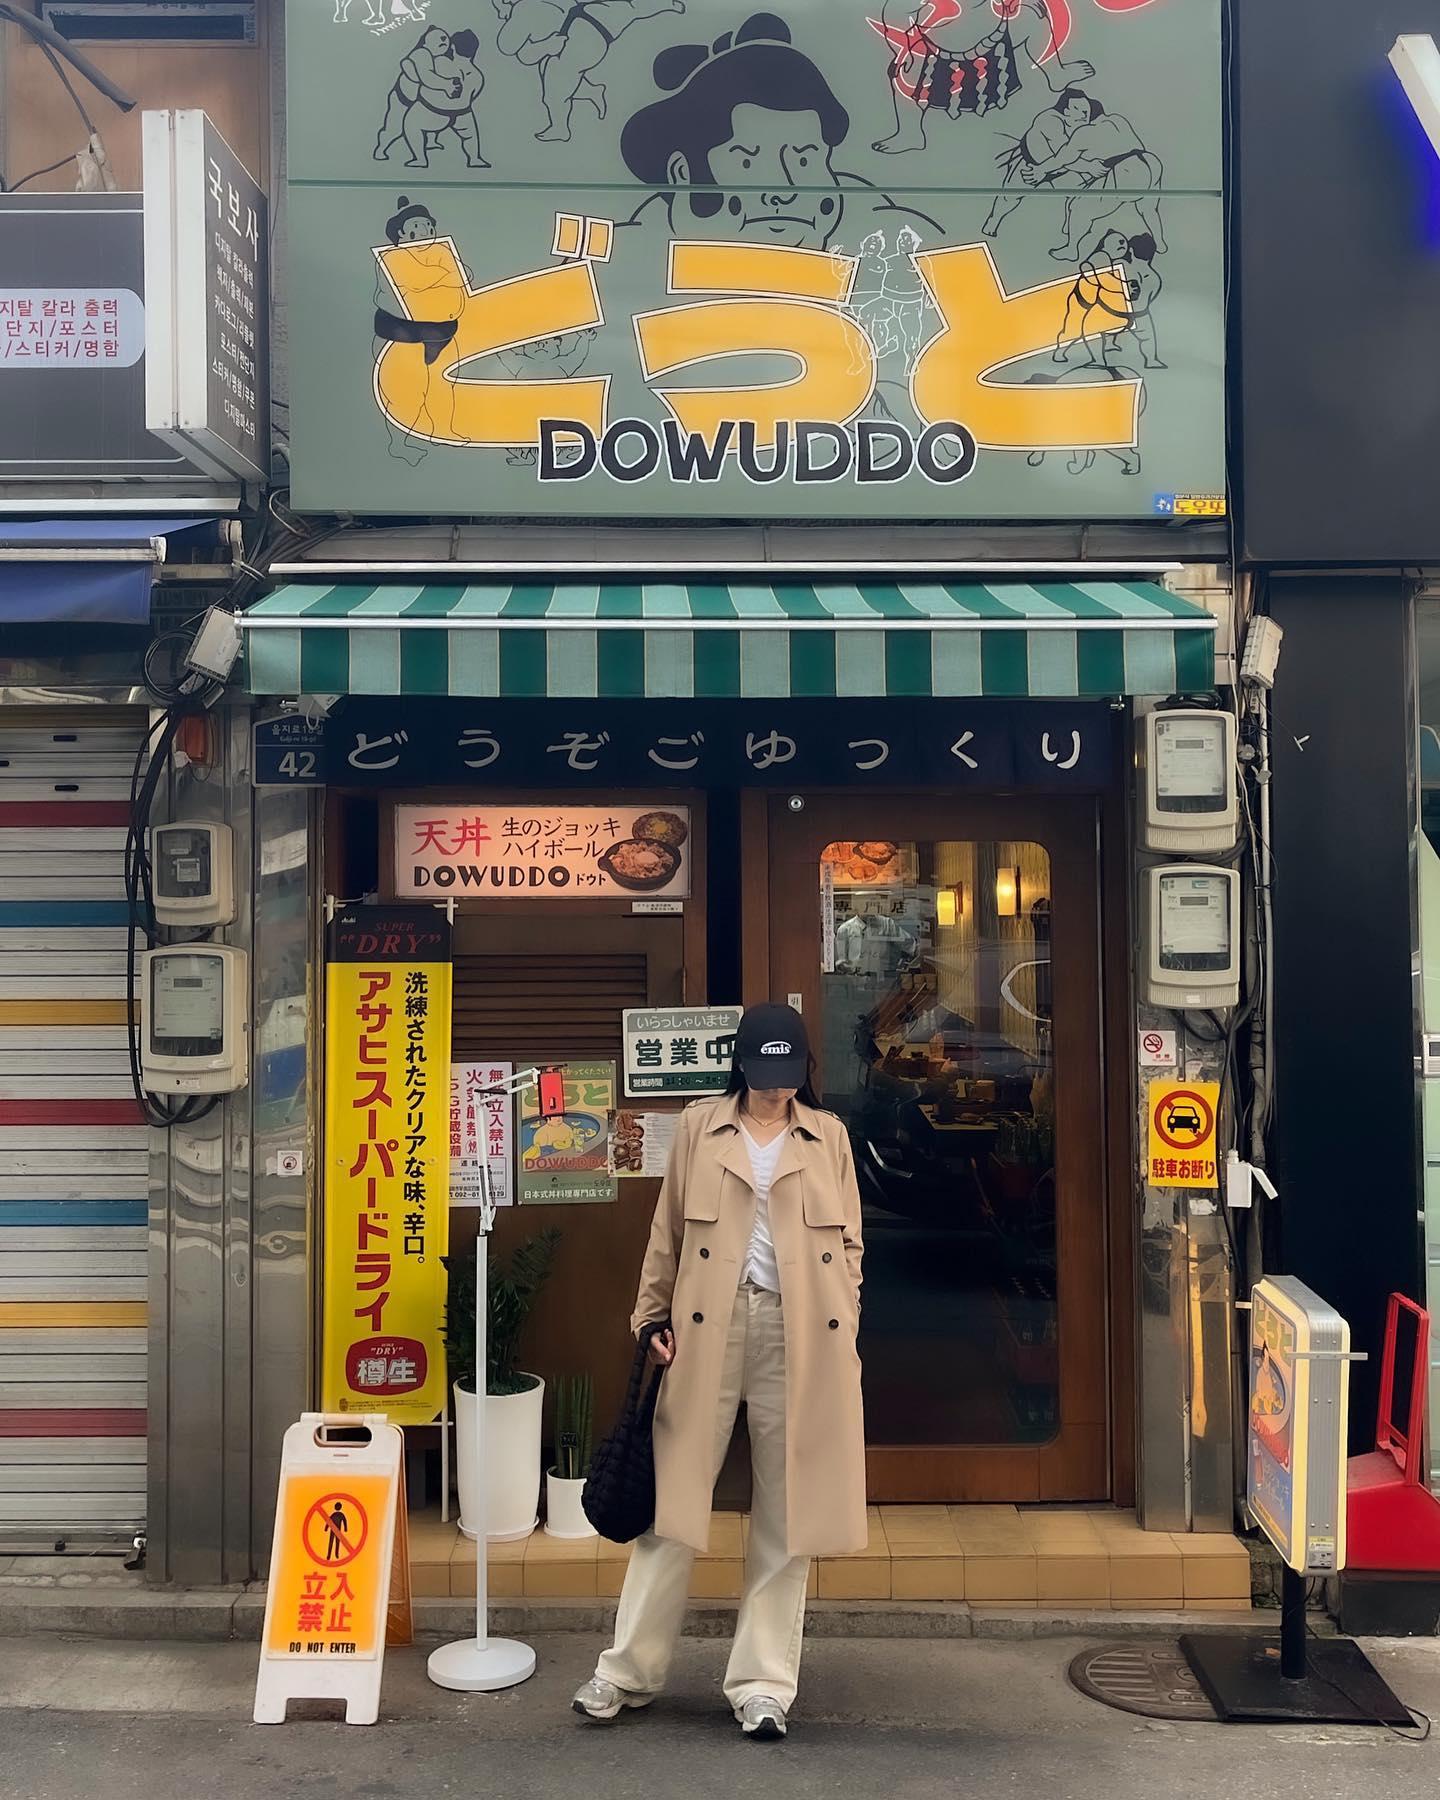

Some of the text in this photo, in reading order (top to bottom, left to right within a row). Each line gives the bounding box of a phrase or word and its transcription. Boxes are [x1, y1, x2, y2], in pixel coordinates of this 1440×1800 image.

[208, 156, 259, 262] 국보사
[41, 299, 76, 317] 칼라
[84, 298, 118, 317] 출력
[370, 210, 1147, 455] どうと
[538, 418, 979, 485] DOWUDDO
[278, 751, 317, 777] 42
[411, 816, 622, 857] 天丼 生のジョッキ
[502, 838, 605, 859] ハイボール
[413, 865, 571, 887] DOWUDDO
[376, 922, 415, 931] SUPER
[636, 1014, 731, 1029] いらっしゃいませ
[635, 1037, 733, 1067] 営業中
[760, 1043, 791, 1055] emis
[403, 971, 428, 1264] 洗練されたクリアな味、辛口。
[349, 971, 399, 1331] アサヒスーパードライ
[1152, 1158, 1216, 1179] 駐車お断り
[356, 1357, 418, 1386] 樽生
[300, 1571, 355, 1601] 立入
[297, 1603, 352, 1633] 禁止
[289, 1642, 356, 1653] DO NOT ENTER
